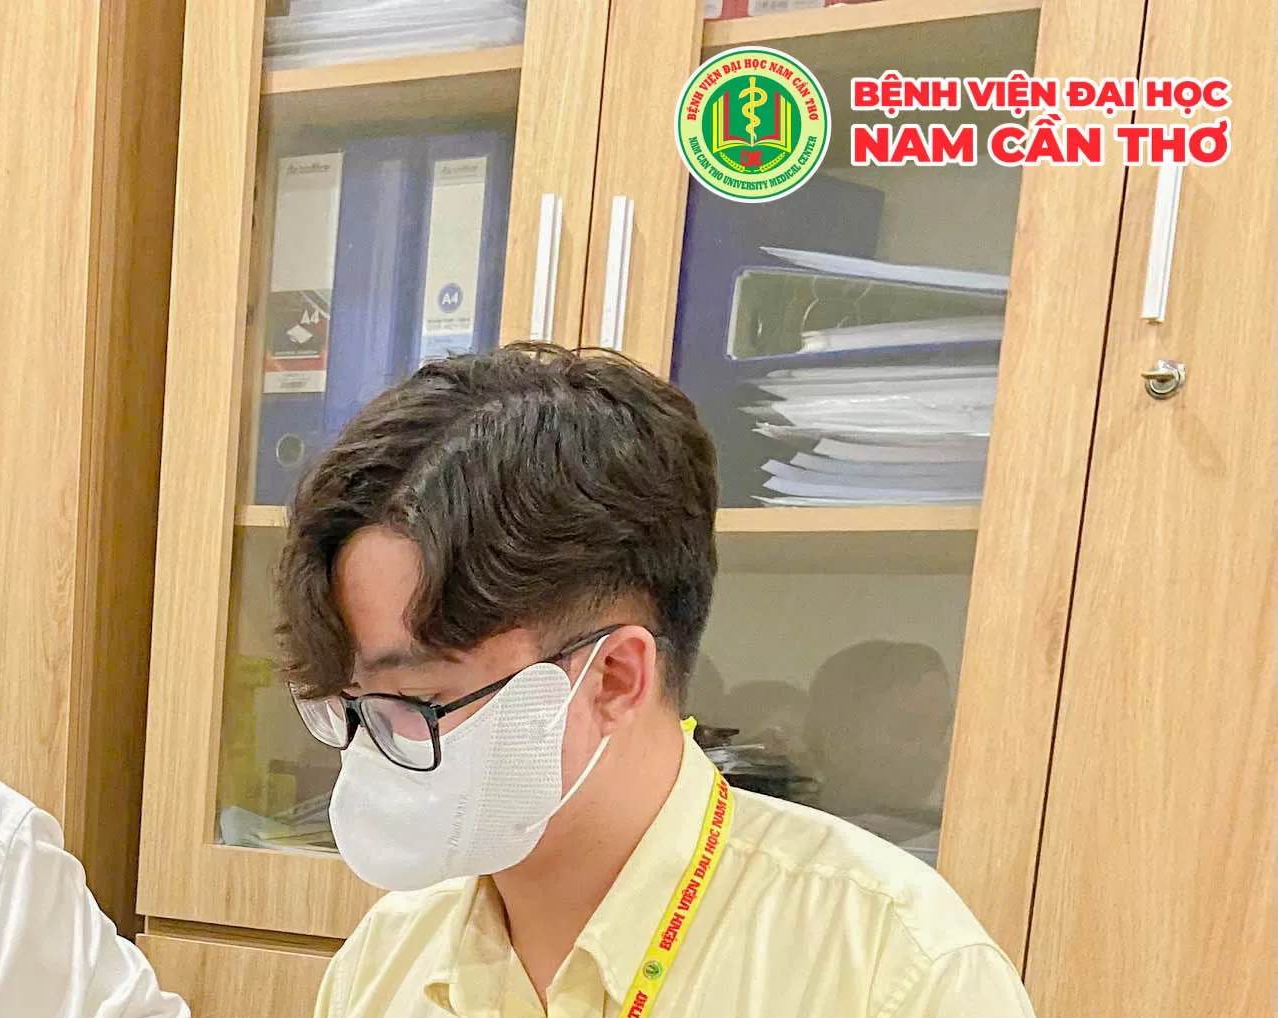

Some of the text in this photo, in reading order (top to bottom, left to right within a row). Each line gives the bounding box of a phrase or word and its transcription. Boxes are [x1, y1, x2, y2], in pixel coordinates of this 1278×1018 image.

[441, 291, 460, 306] A4
[300, 308, 320, 325] A4
[712, 798, 728, 829] NAM
[705, 828, 720, 855] HỌC
[694, 855, 712, 880] ĐẠI
[678, 878, 701, 911] VIỆN
[659, 912, 685, 952] BỆNH
